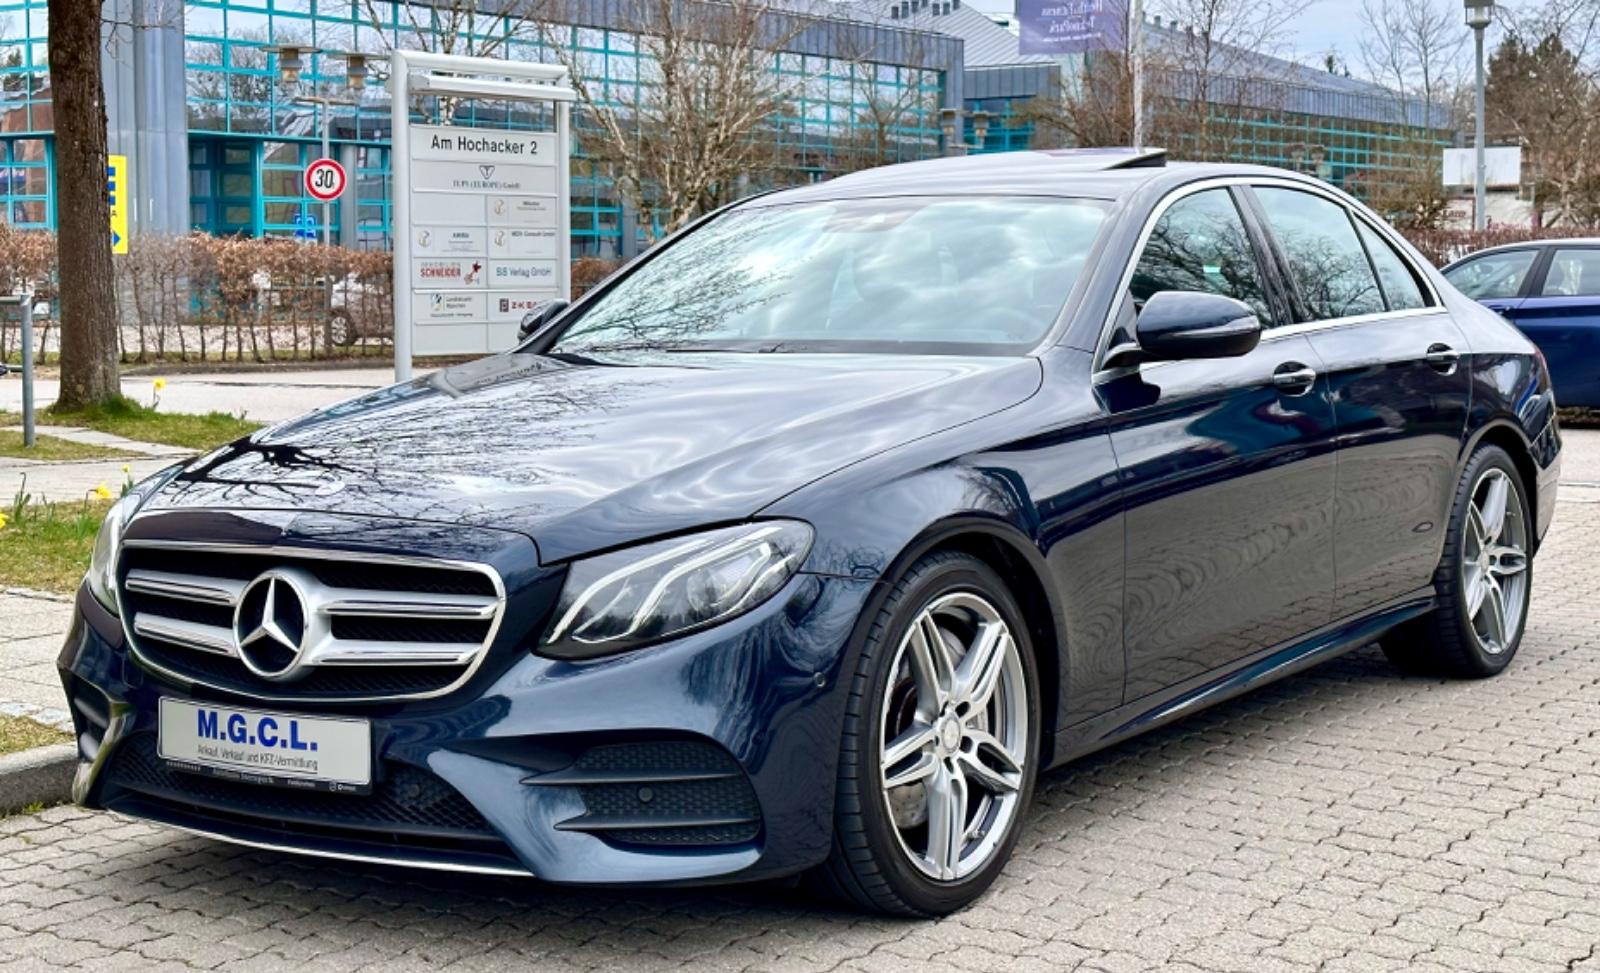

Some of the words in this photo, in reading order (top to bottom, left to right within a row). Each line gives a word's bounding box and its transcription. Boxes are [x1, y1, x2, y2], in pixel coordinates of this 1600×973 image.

[431, 134, 452, 150] Am
[458, 136, 525, 154] Hochacker
[530, 141, 538, 155] 2
[315, 168, 334, 189] 30
[420, 267, 461, 278] SCHNEIDER
[197, 709, 318, 752] M.G.C.L.
[221, 748, 245, 761] Verkauf
[246, 751, 259, 763] und
[259, 752, 318, 771] KFZ-Vermittlung
